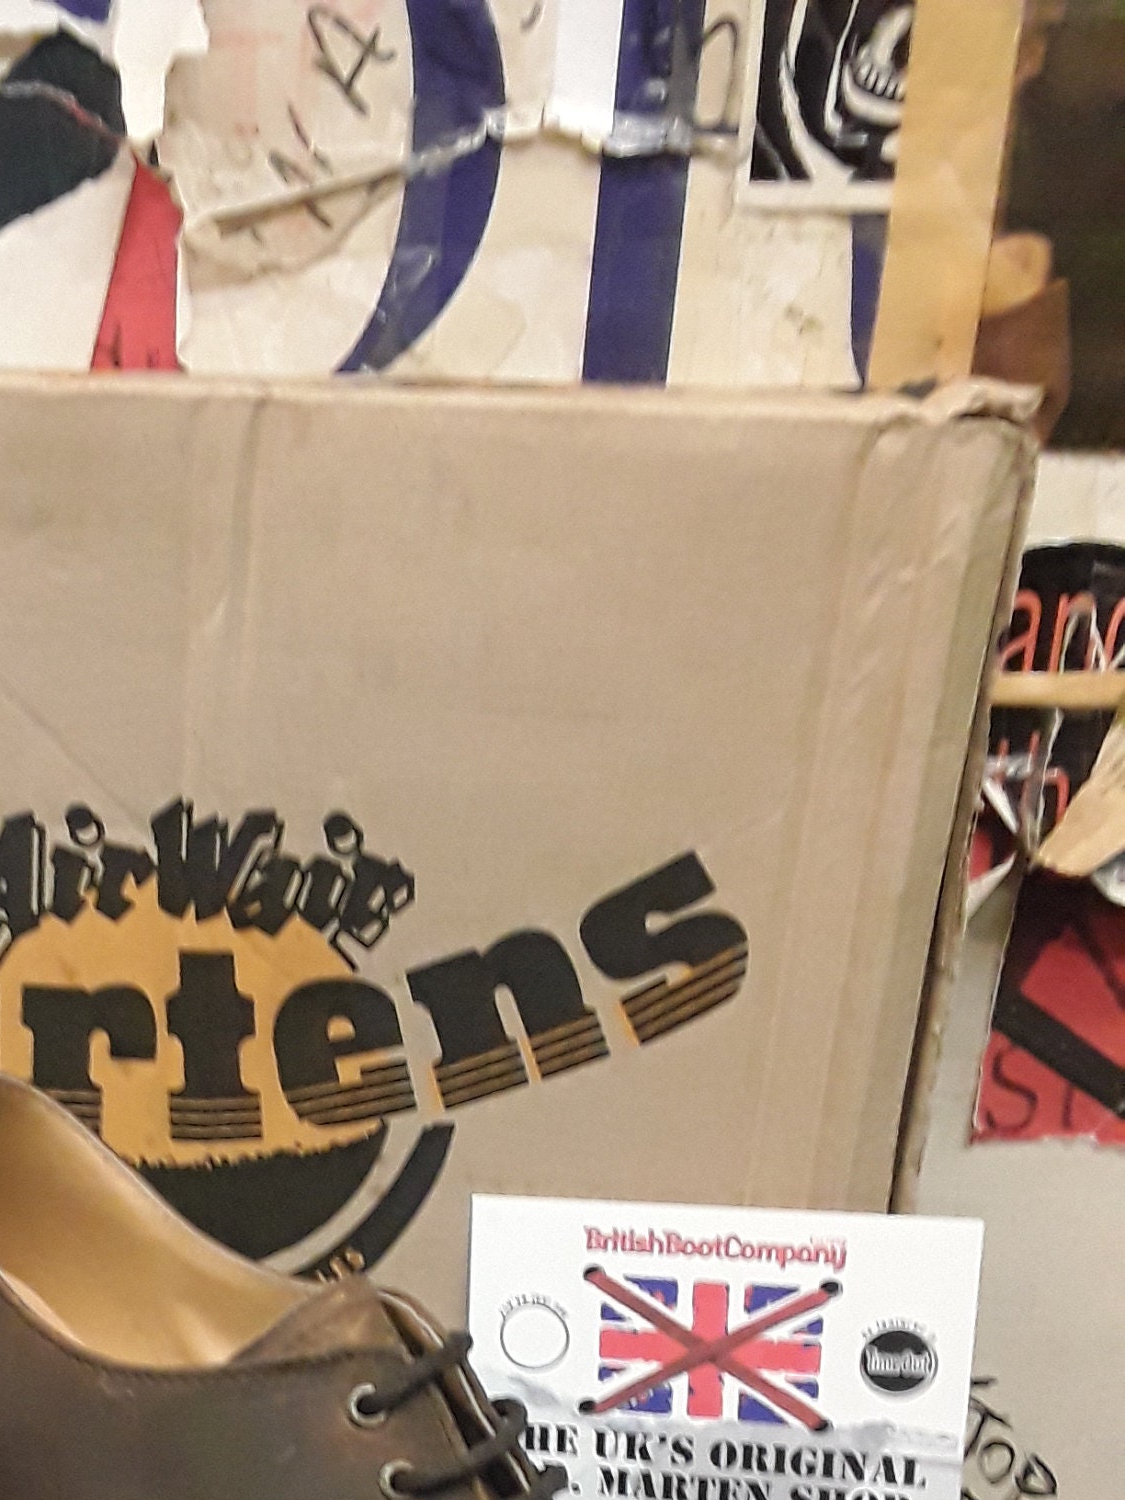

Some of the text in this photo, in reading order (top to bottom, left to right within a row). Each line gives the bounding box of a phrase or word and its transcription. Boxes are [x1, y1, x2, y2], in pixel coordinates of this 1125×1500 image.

[583, 1225, 848, 1271] BritishBootCompany
[524, 1422, 928, 1490] HE UK'S ORIGINAL
